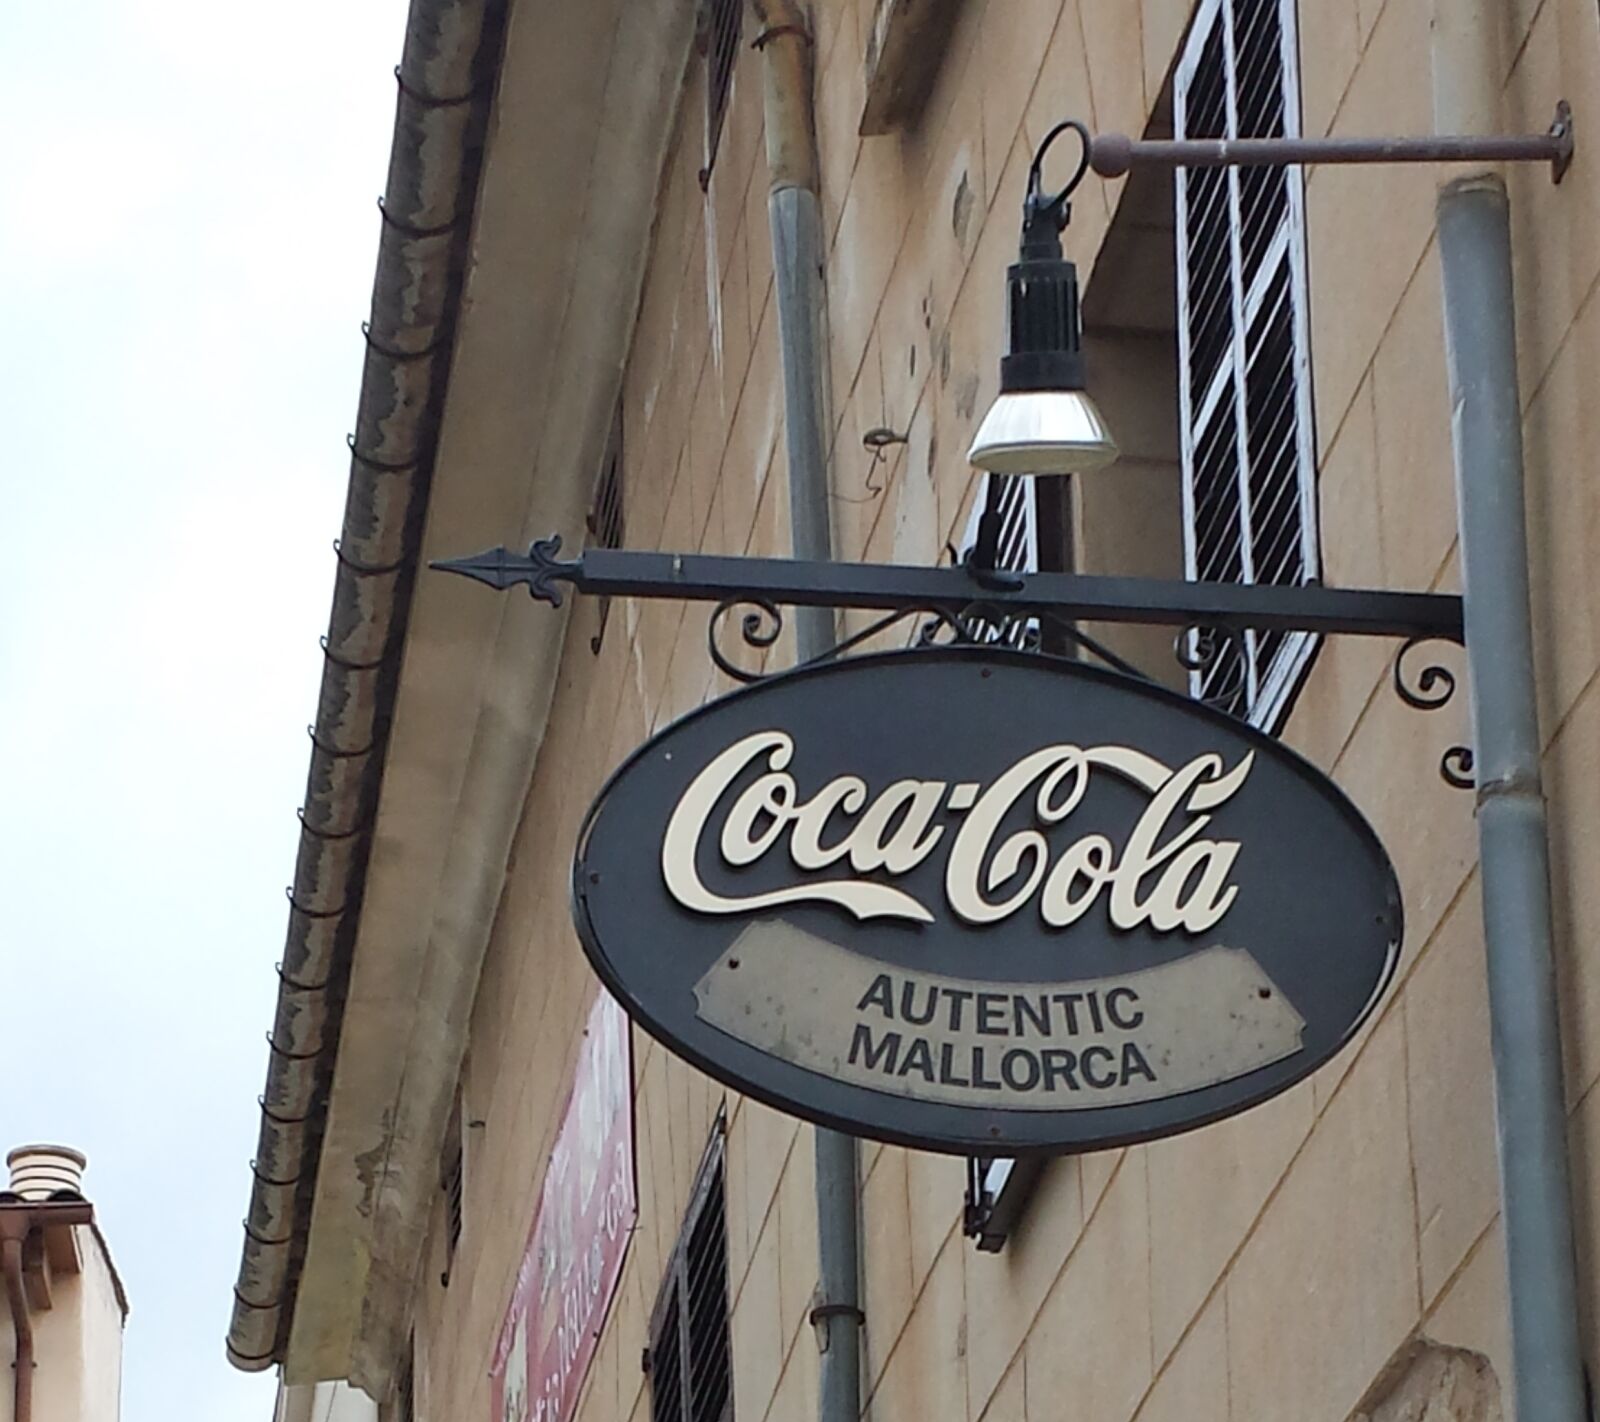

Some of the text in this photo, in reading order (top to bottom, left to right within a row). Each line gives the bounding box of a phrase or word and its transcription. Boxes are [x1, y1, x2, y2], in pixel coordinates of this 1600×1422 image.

[662, 730, 1255, 934] Coca-Cola
[856, 973, 1144, 1036] AUTENTIC
[847, 1024, 1157, 1092] MALLORCA
